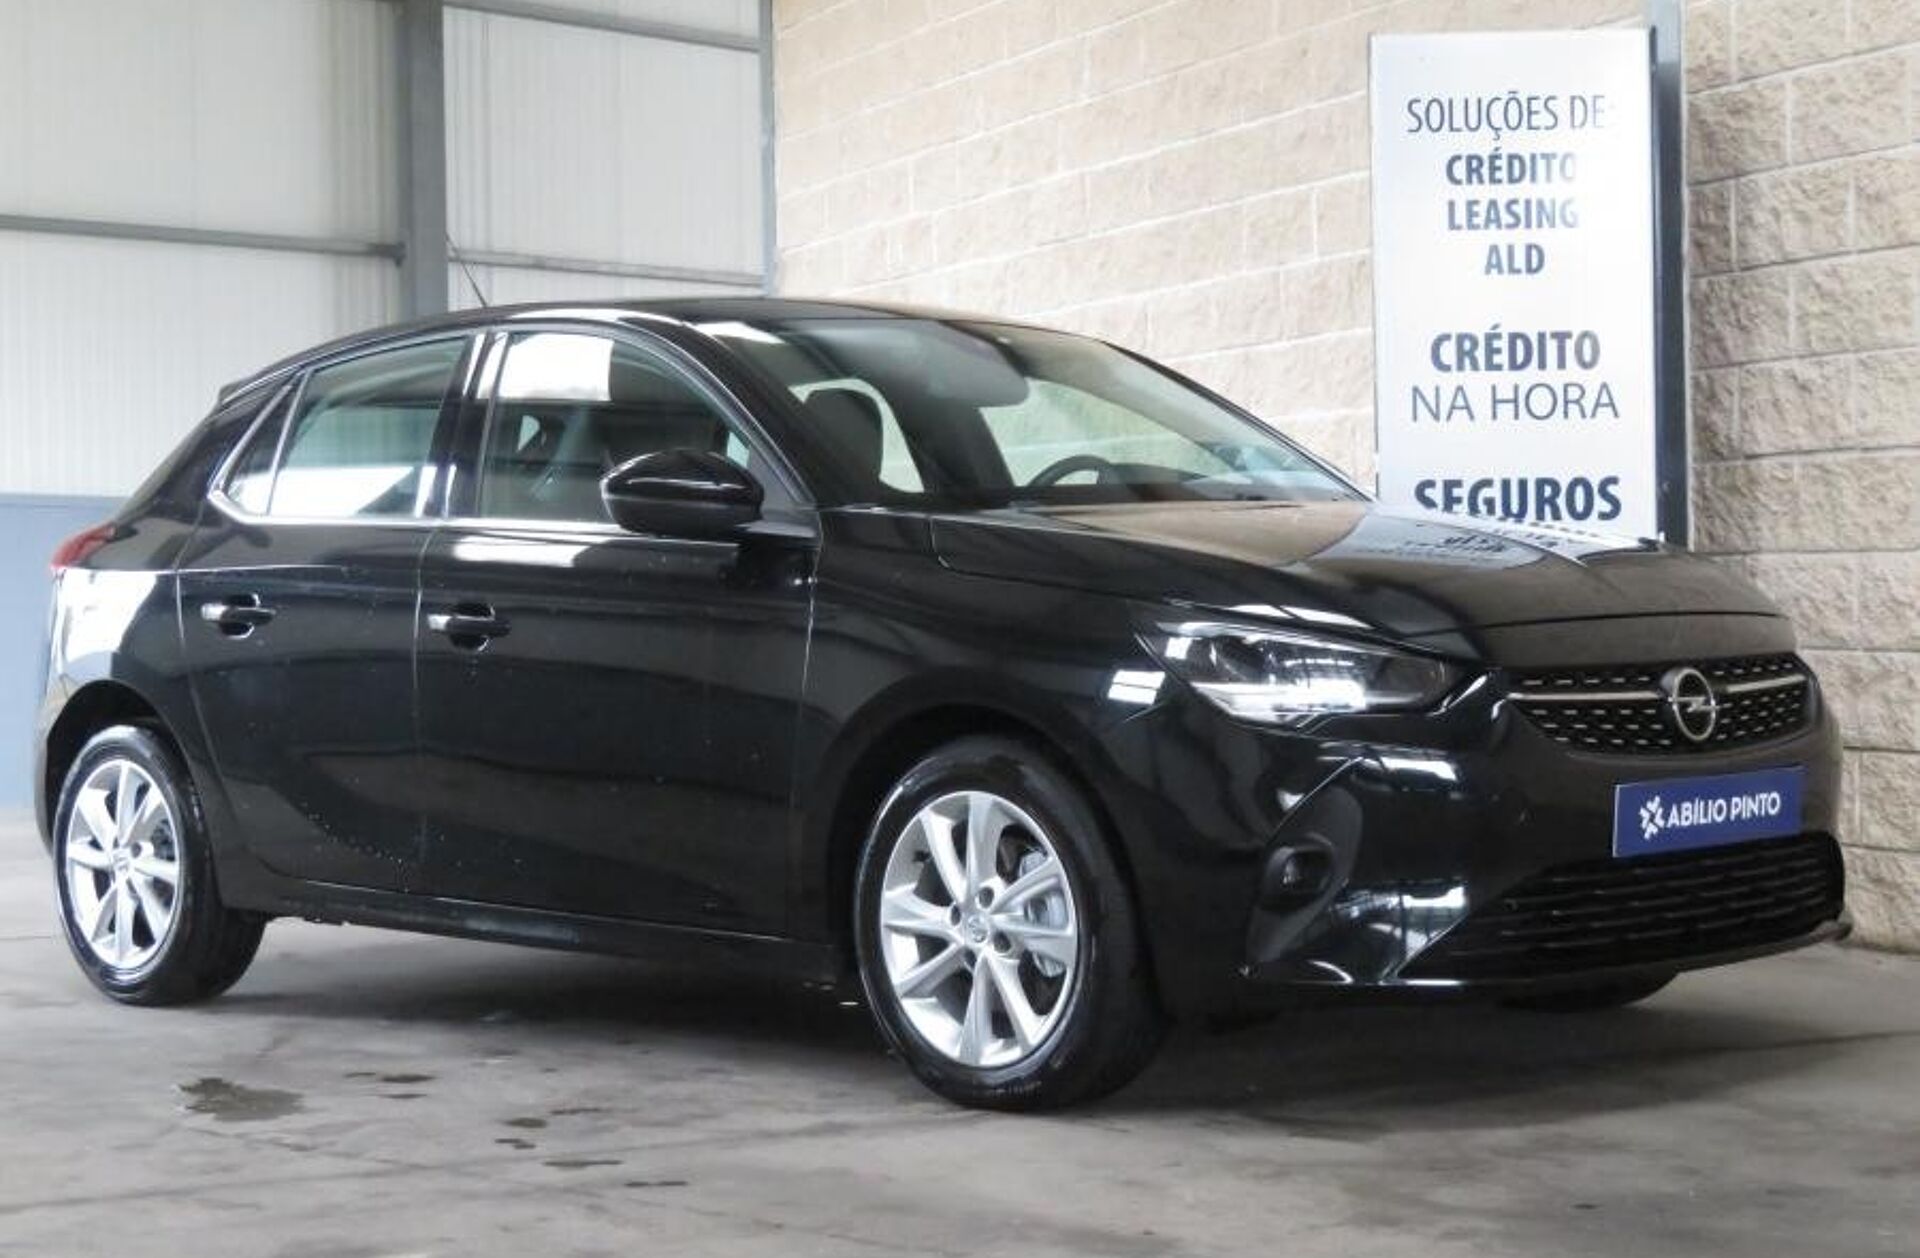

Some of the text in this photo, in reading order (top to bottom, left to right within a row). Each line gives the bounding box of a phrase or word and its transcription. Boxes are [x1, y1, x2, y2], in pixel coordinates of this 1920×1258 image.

[1406, 91, 1559, 140] SOLUÇÕES
[1446, 146, 1578, 185] CRÉDITO
[1447, 198, 1579, 231] LEASING
[1484, 243, 1546, 275] ALD
[1430, 323, 1601, 373] CRÉDITO
[1411, 381, 1620, 422] NA HORA
[1414, 475, 1622, 521] SEGUROS
[1730, 791, 1781, 821] PINTO
